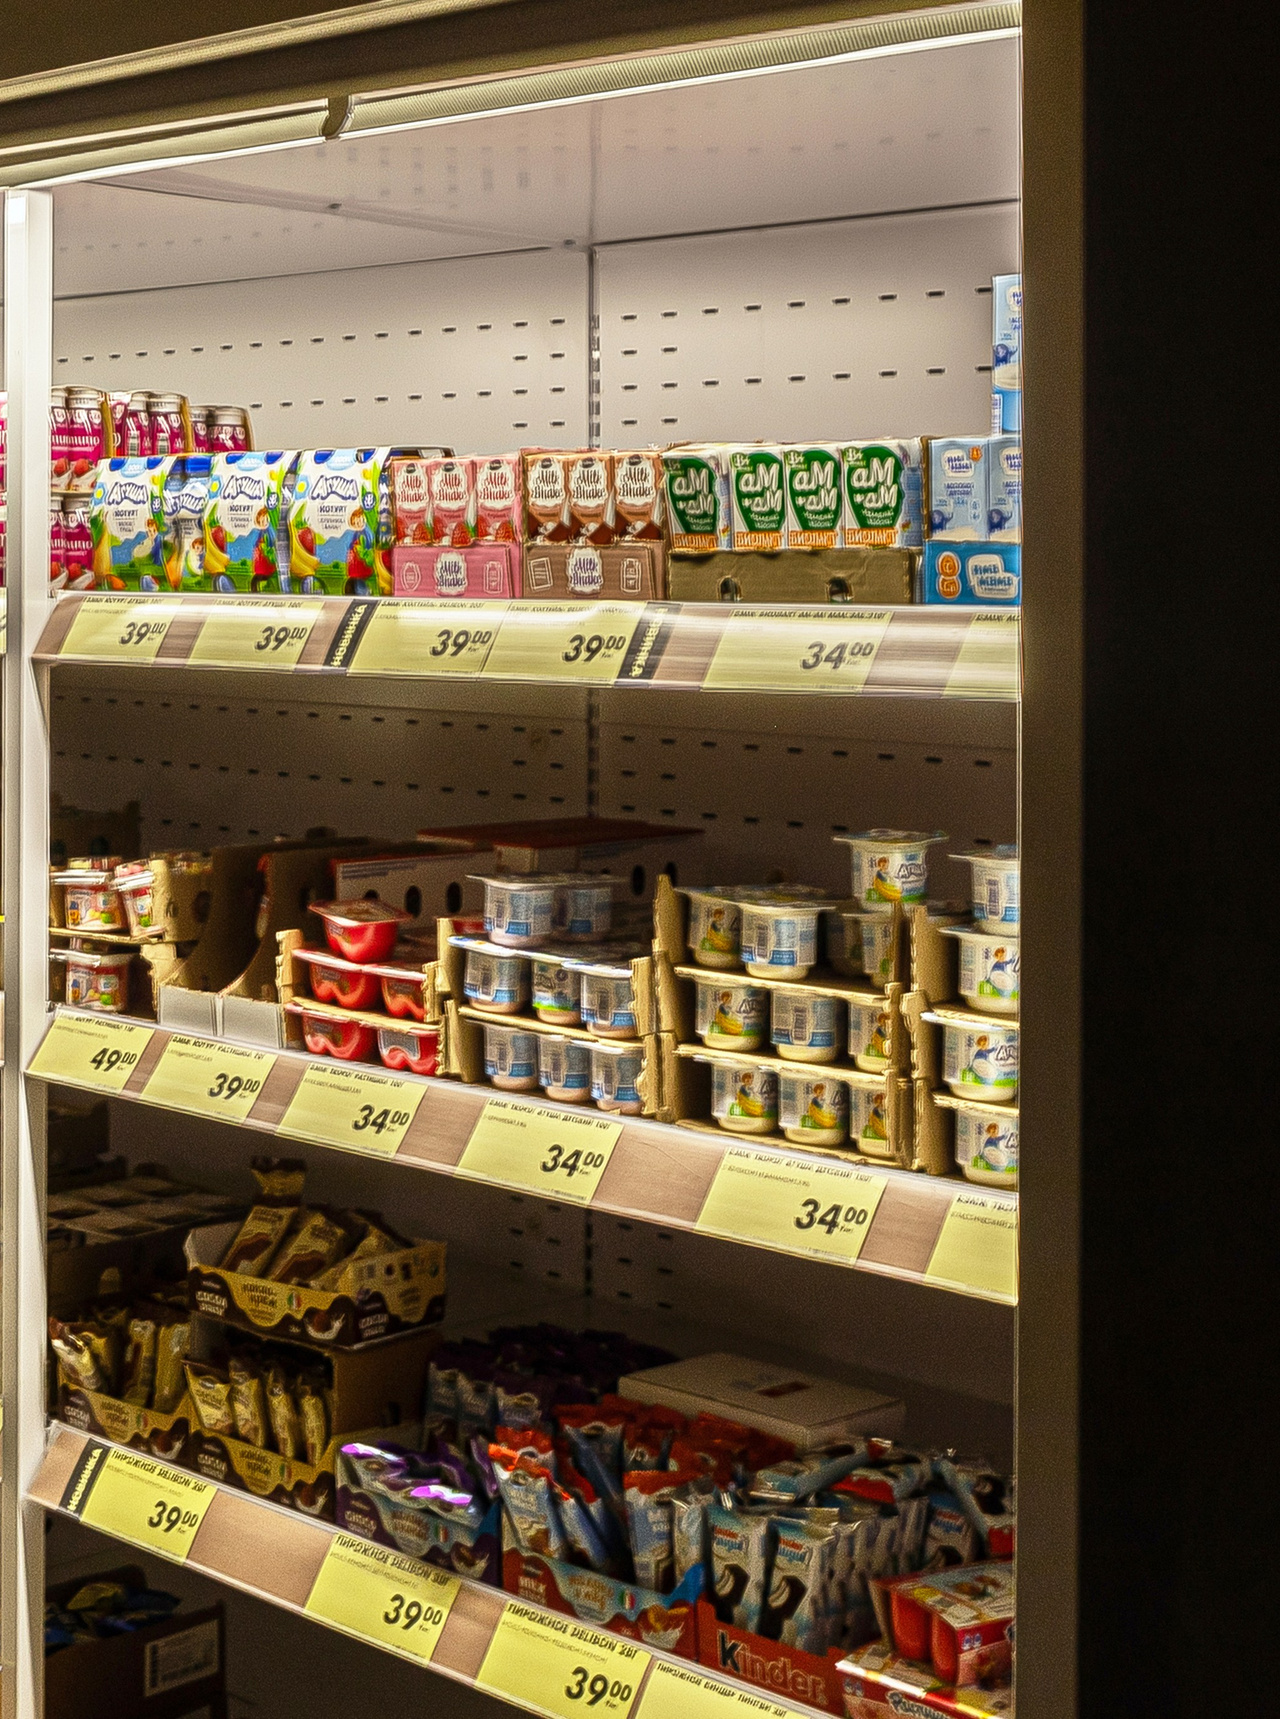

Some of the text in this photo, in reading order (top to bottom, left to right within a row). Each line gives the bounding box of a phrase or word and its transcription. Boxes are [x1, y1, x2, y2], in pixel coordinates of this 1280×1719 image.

[331, 603, 368, 668] НОВИНКА
[66, 1448, 104, 1513] НОВИНКА
[334, 1535, 391, 1563] ПИРОЖНОЕ
[389, 1555, 433, 1579] DELIBON
[506, 1602, 570, 1633] ПИРОЖНОЕ
[717, 1629, 829, 1706] Kinder
